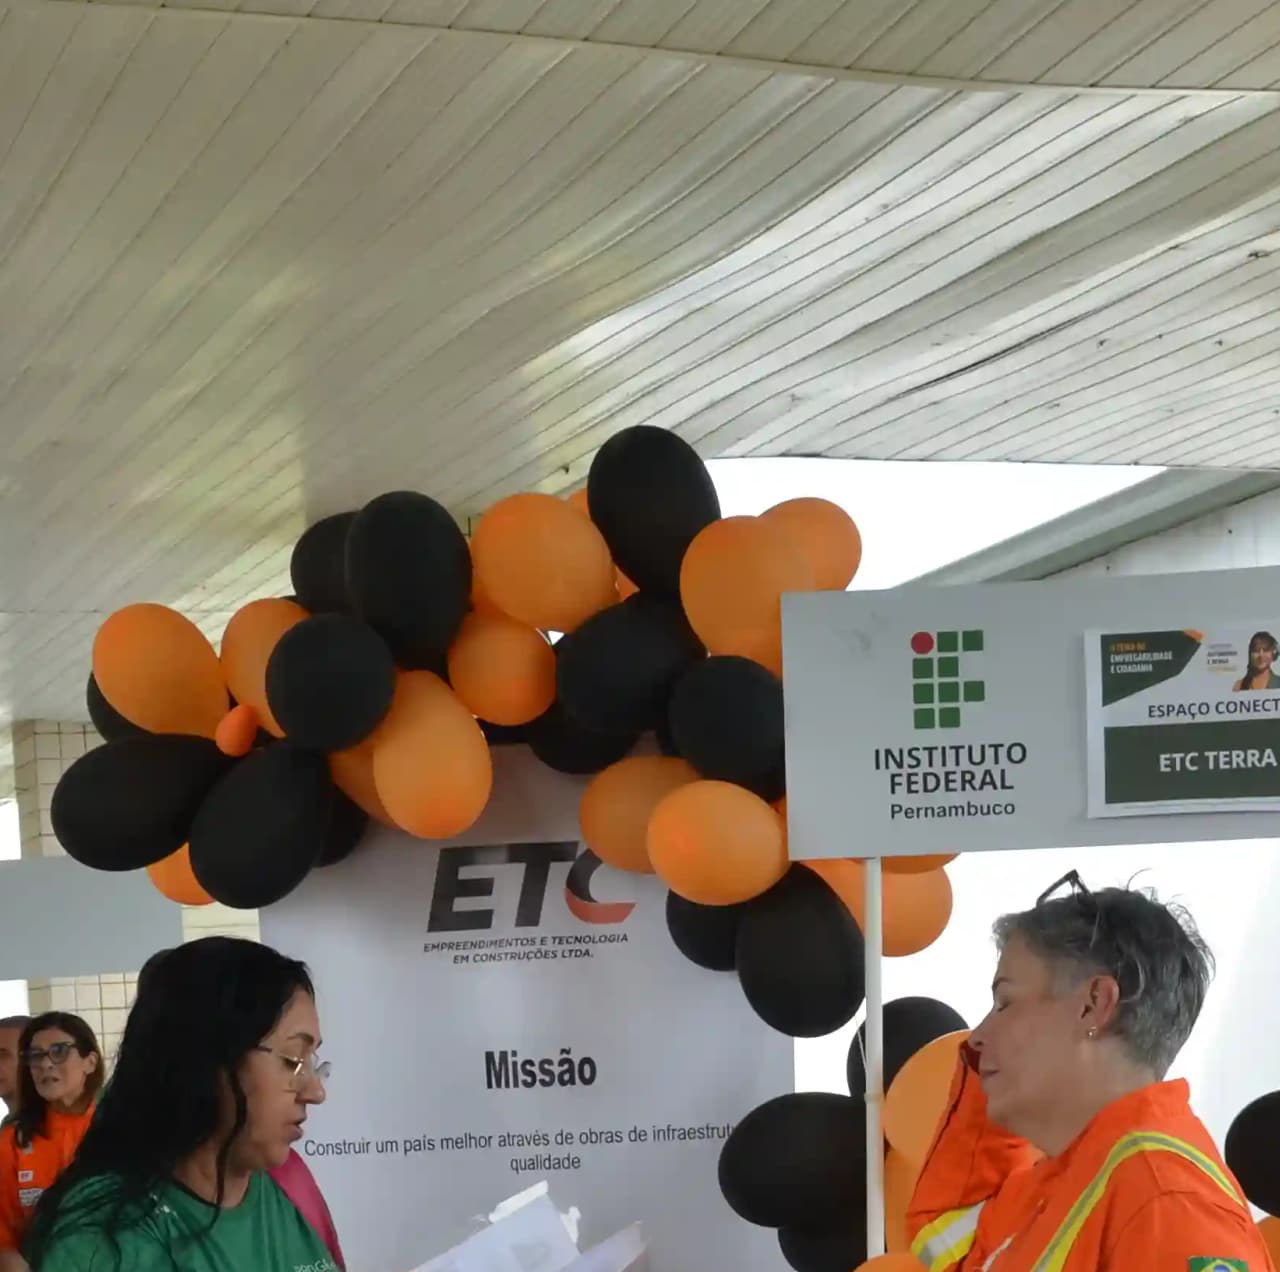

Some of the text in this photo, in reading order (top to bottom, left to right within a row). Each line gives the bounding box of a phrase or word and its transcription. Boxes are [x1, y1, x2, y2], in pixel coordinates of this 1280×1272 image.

[1148, 702, 1209, 719] ESPAÇO
[874, 742, 1028, 771] INSTITUTO
[1159, 748, 1278, 772] ETC TERRA
[889, 769, 1015, 796] FEDERAL
[890, 801, 1015, 820] Pernambuco
[427, 841, 637, 933] ETC
[424, 934, 629, 953] EMPREENDIMENTOS E TECNOLOGIA
[453, 949, 593, 964] EM CONSTRUÇÕES LTDA.
[485, 1048, 597, 1091] Missão
[304, 1123, 736, 1161] Construir um país melhor através de obras de infraestrut
[511, 1153, 581, 1175] qualidade
